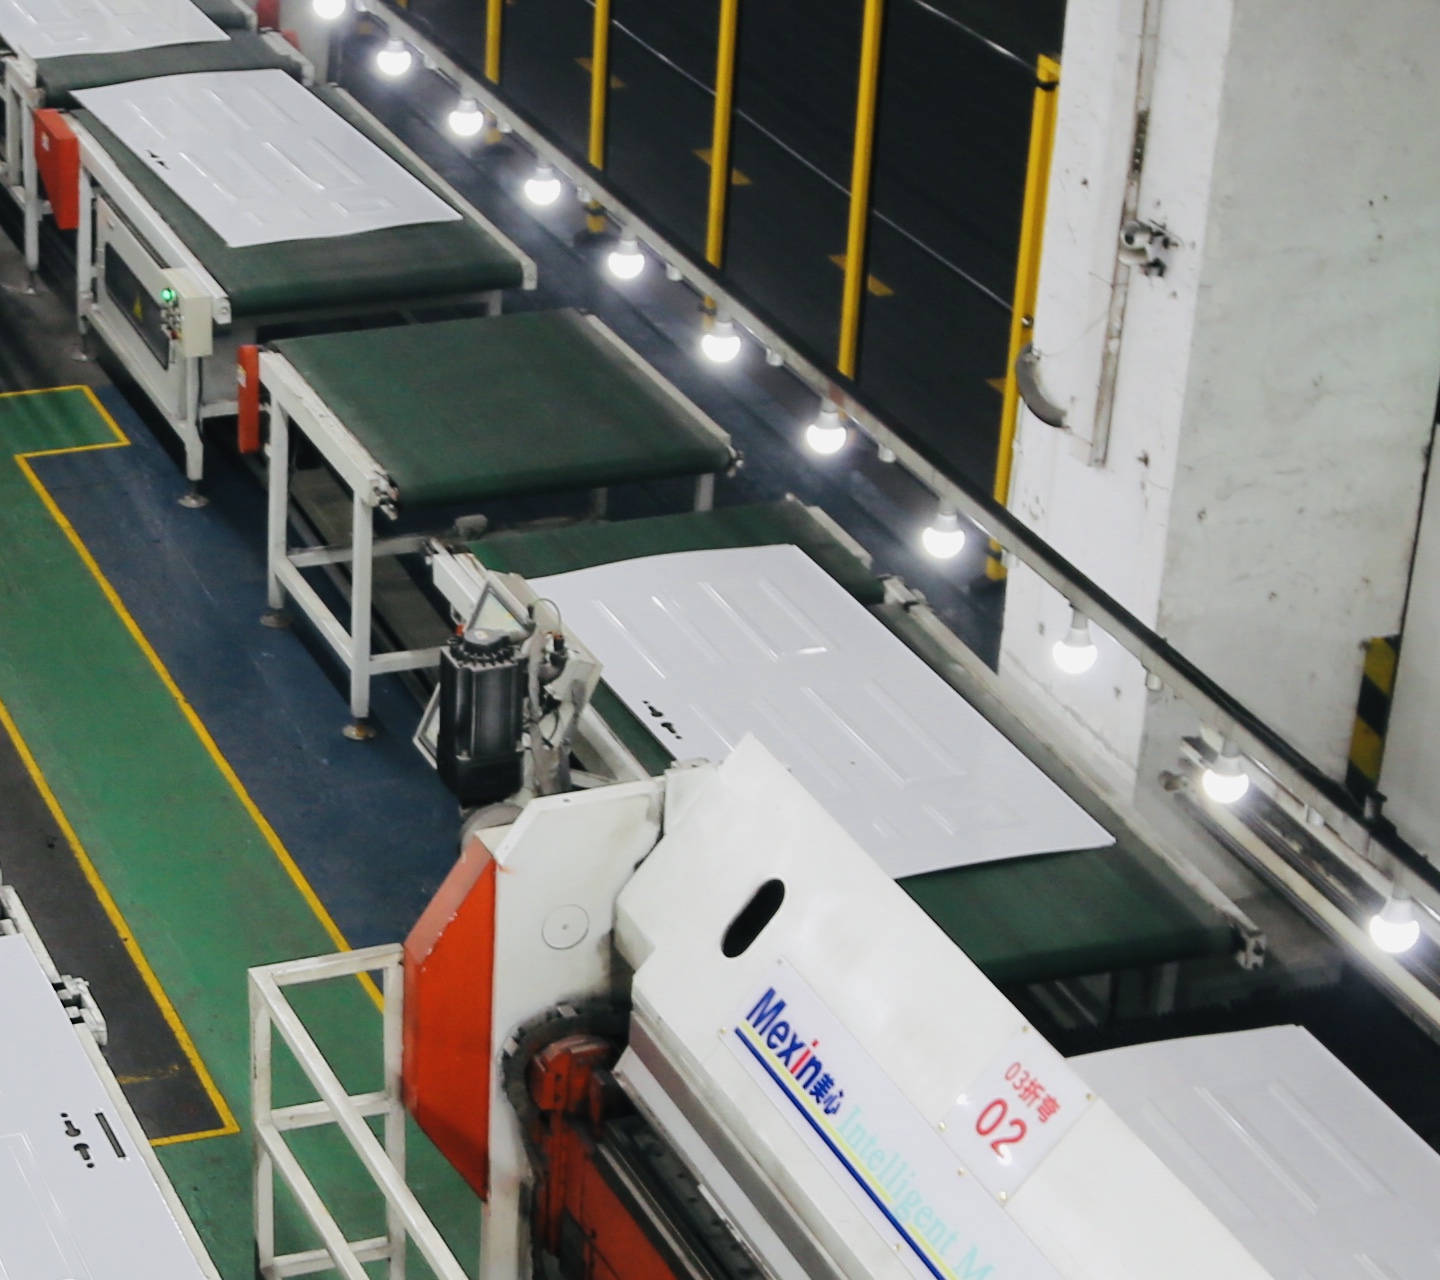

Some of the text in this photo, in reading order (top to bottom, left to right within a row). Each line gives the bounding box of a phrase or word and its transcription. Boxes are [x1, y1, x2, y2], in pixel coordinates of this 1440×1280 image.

[746, 986, 844, 1115] Mexin 美心
[1003, 1060, 1061, 1126] 03折弯
[974, 1100, 1029, 1161] 02
[837, 1104, 961, 1258] Intelligent
